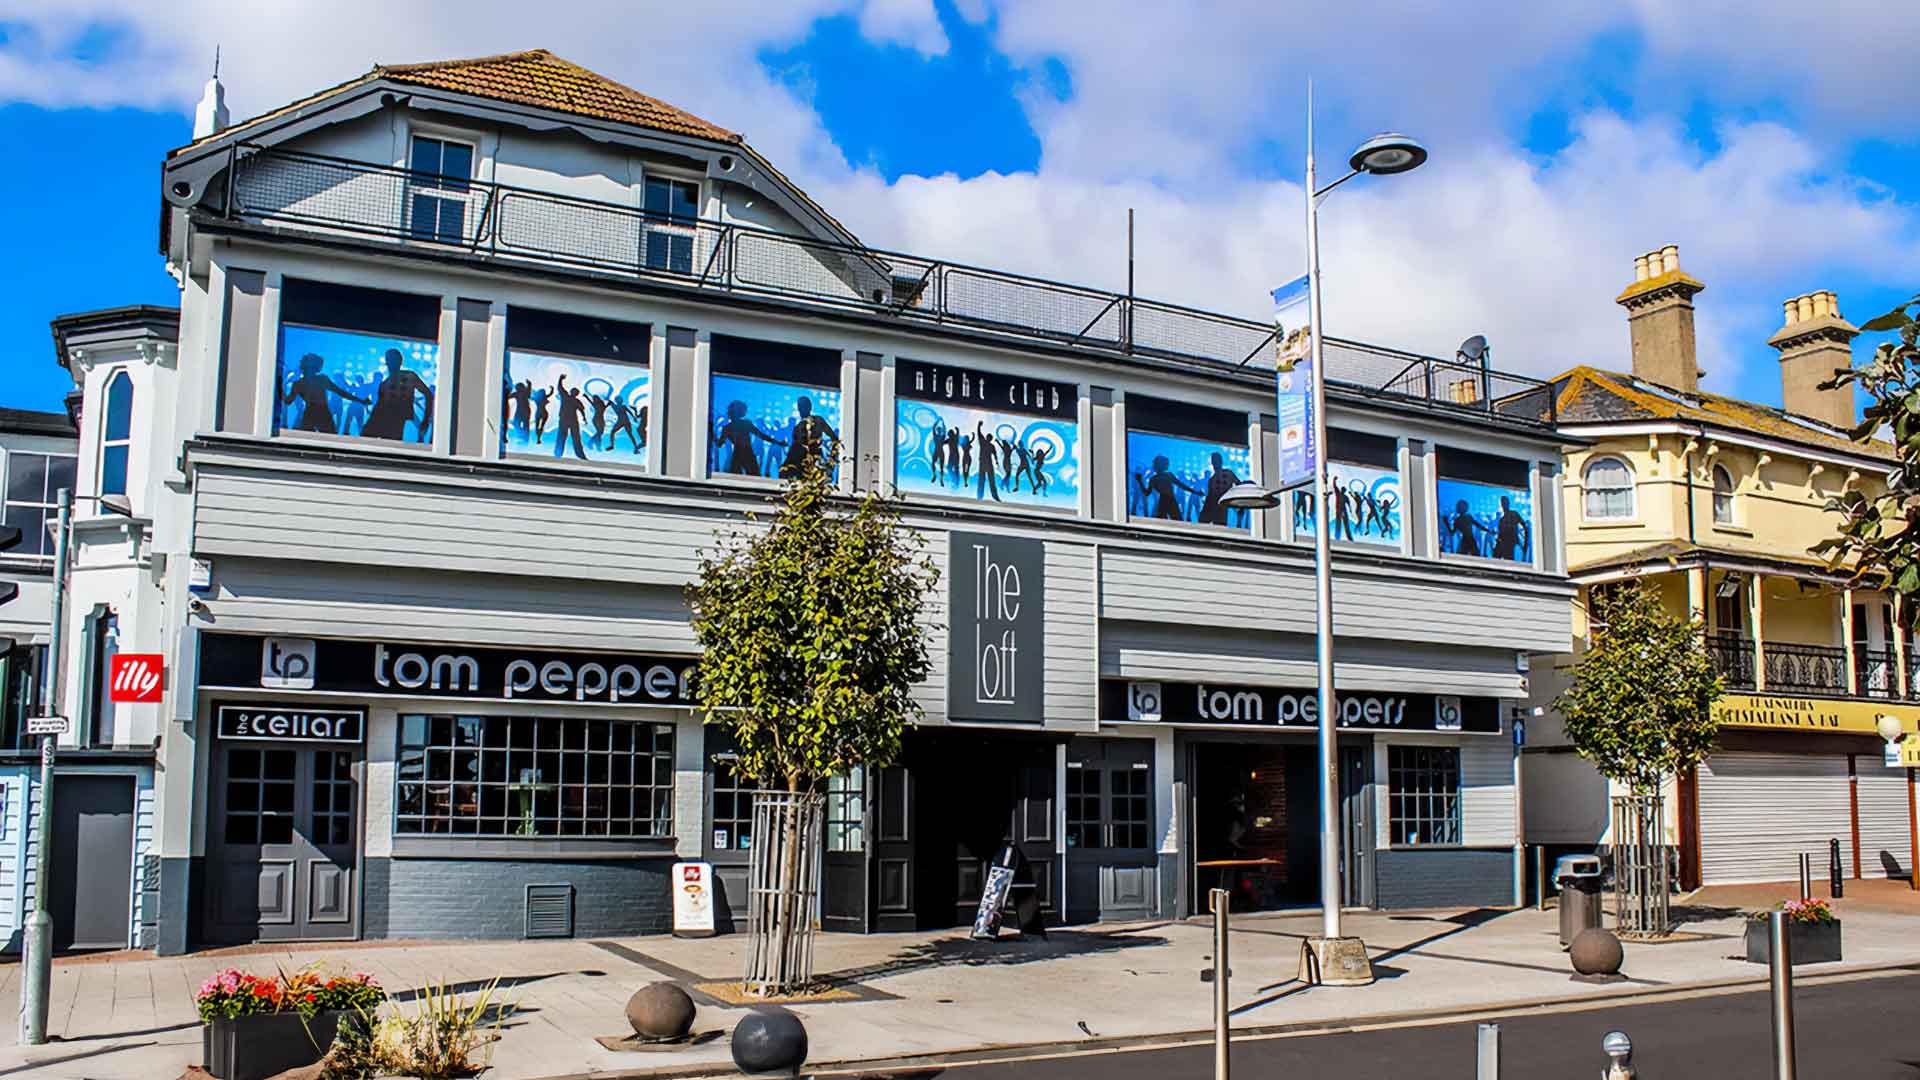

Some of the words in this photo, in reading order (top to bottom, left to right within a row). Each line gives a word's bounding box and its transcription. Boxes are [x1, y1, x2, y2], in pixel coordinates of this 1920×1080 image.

[915, 368, 985, 400] night
[1009, 382, 1060, 411] club
[972, 544, 1021, 621] The
[113, 660, 160, 699] illy
[270, 640, 309, 685] tp
[374, 643, 479, 693] tom
[503, 659, 697, 703] pepper
[252, 714, 347, 737] cellar
[1198, 685, 1263, 721] tom
[1278, 694, 1406, 727] pepers
